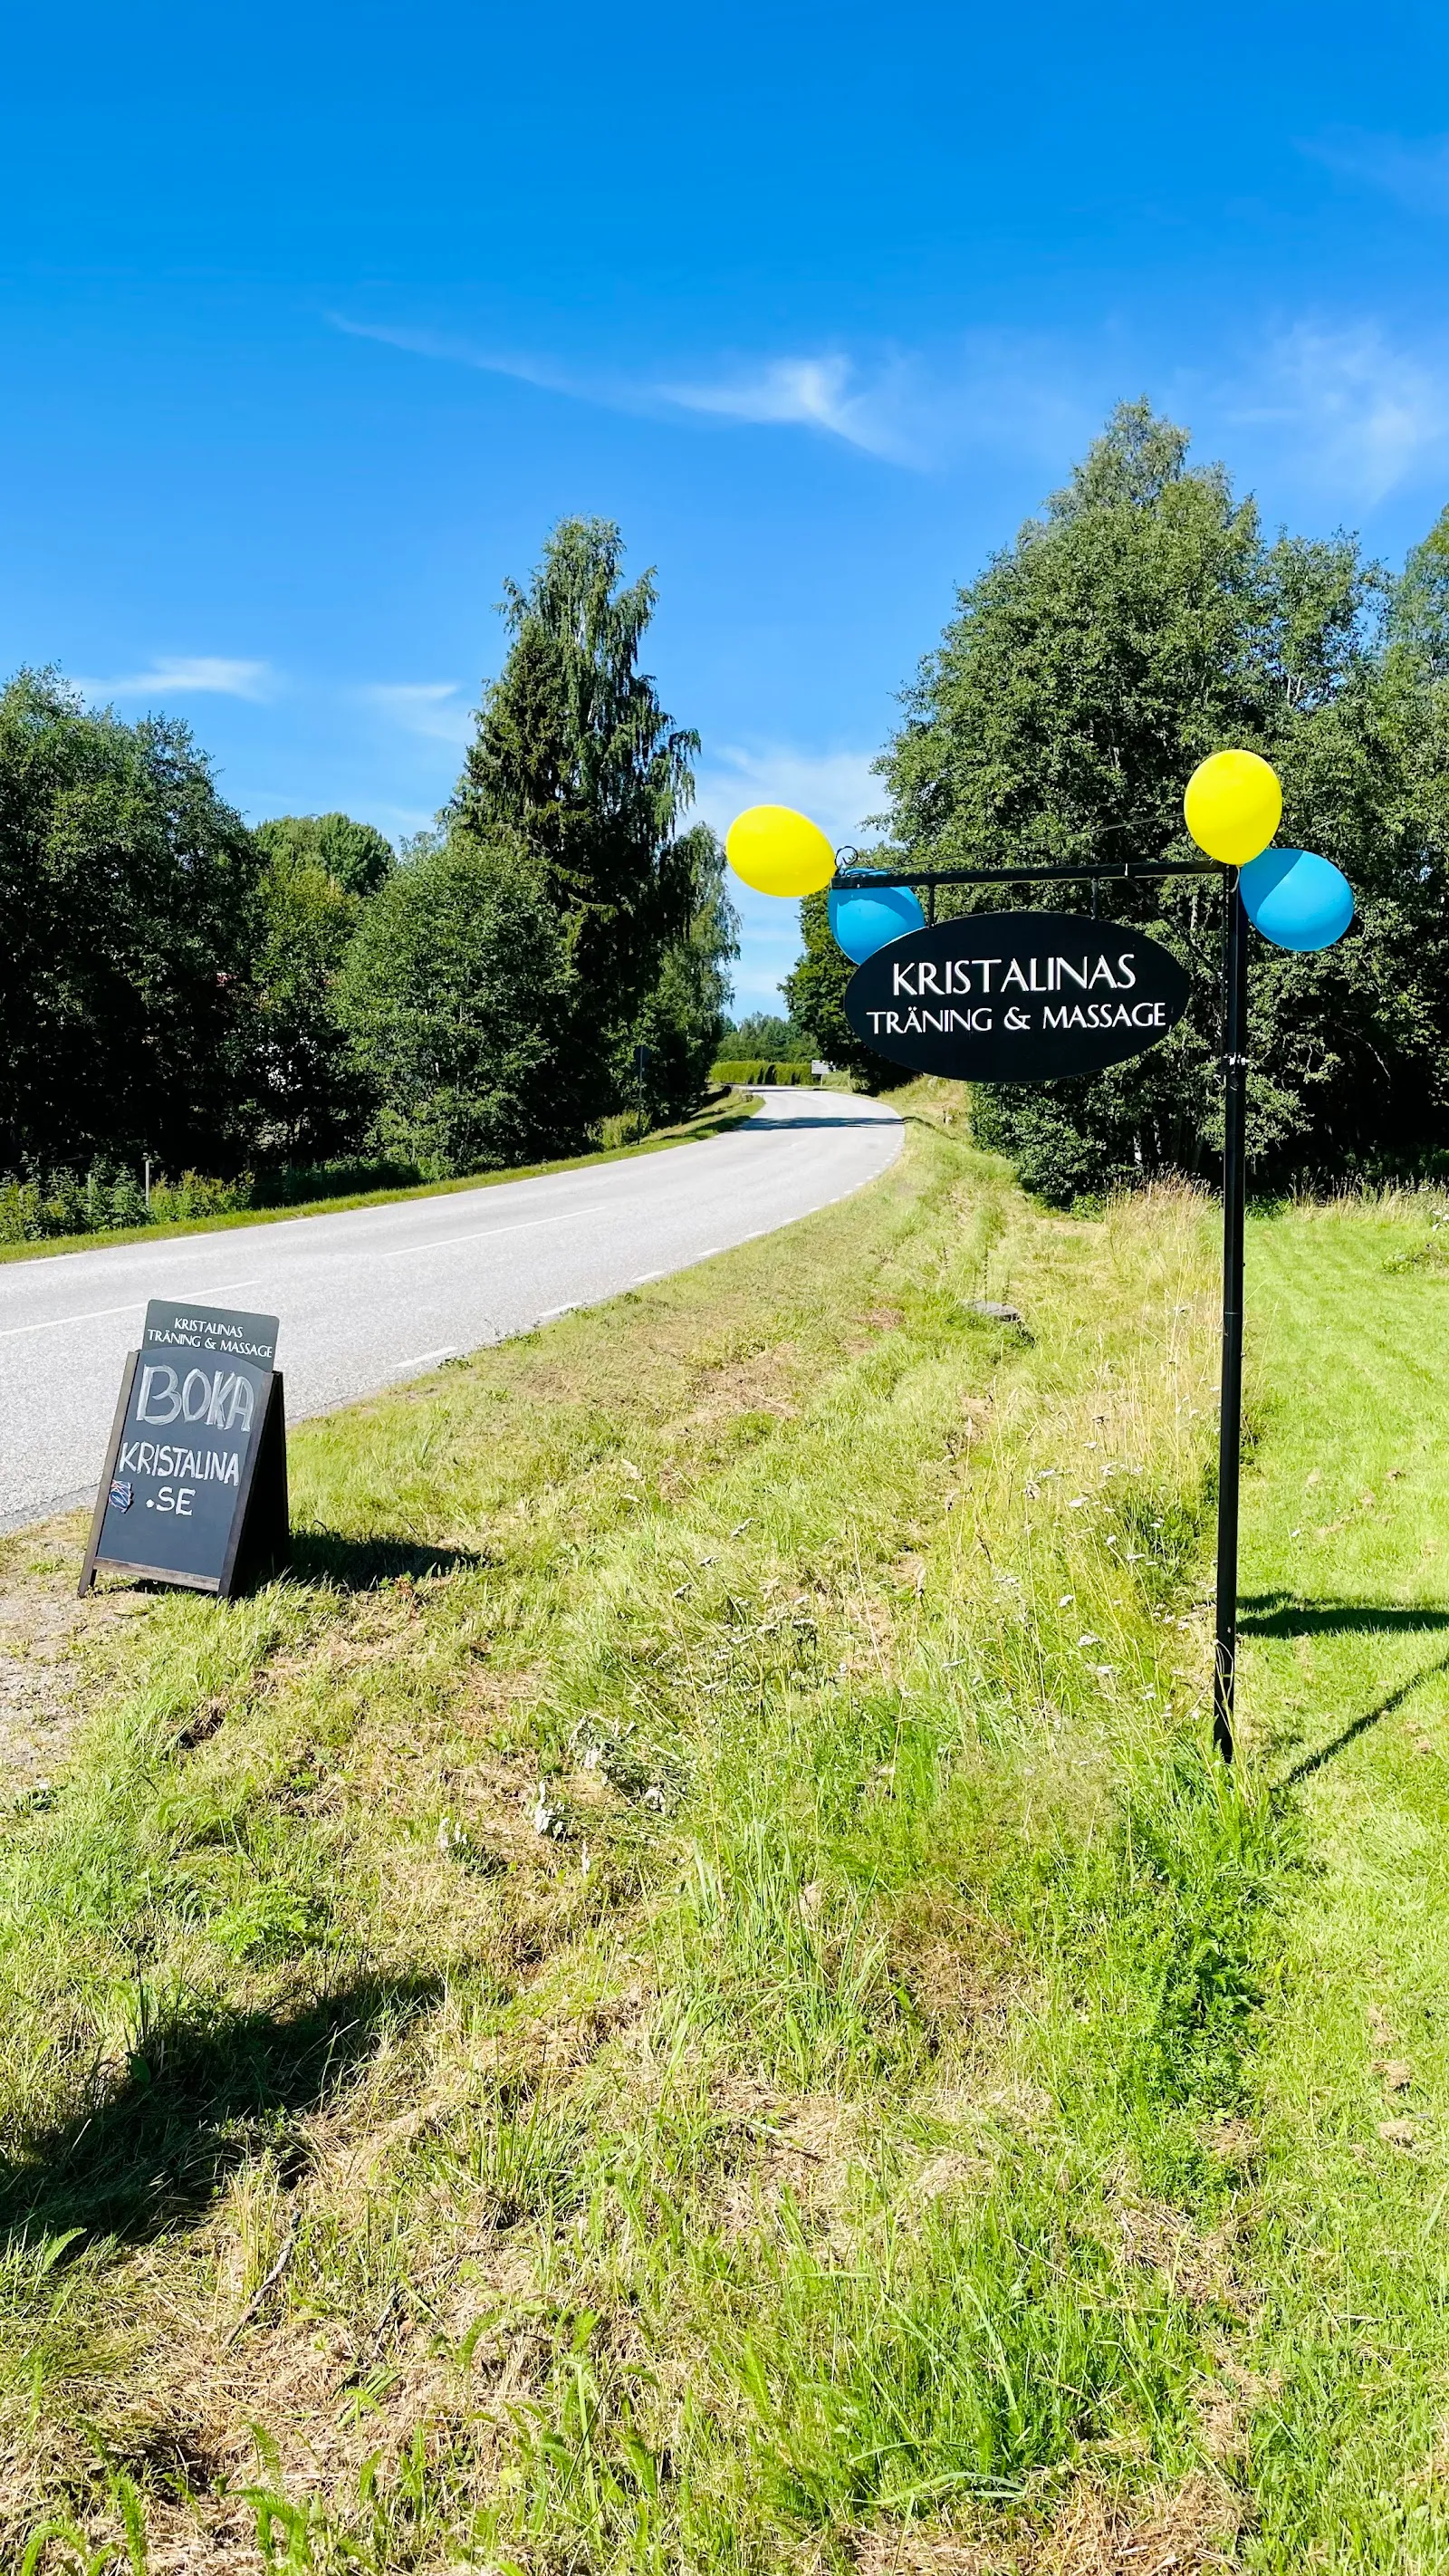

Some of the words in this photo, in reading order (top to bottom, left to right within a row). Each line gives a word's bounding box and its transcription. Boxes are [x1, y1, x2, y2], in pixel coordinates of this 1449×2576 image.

[893, 954, 1136, 995] KRISTALINAS
[867, 1006, 993, 1034] TRÄNING
[1004, 1006, 1031, 1031] &
[1043, 1002, 1166, 1029] MASSAGE
[147, 1329, 201, 1348] TRÄNING
[204, 1337, 216, 1350] &
[219, 1340, 273, 1358] MASSAGE
[174, 1317, 244, 1338] KRISTALINAS
[136, 1364, 254, 1432] BOKA
[119, 1441, 240, 1485] KRISTALINA
[145, 1486, 197, 1516] .SE
